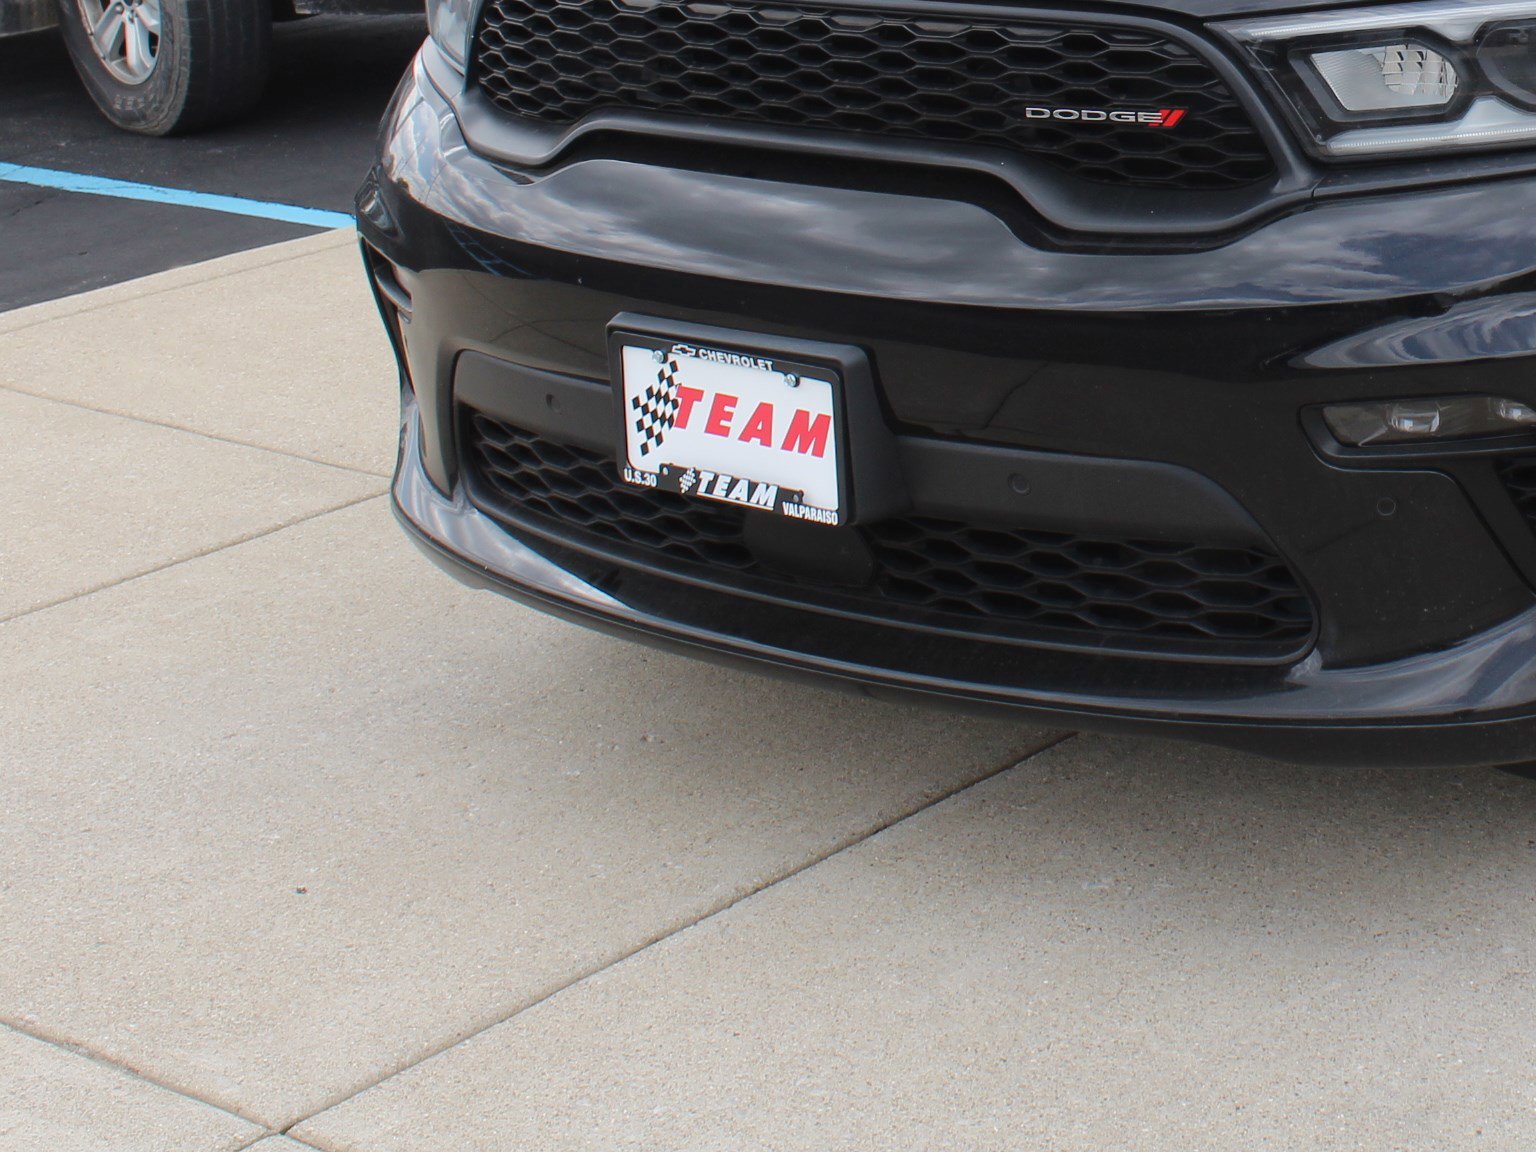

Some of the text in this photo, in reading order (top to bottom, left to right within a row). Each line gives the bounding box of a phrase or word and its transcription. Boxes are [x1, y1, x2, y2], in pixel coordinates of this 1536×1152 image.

[1025, 107, 1164, 124] DODGE
[698, 348, 774, 372] CHEVROLET
[673, 385, 832, 459] TEAM
[696, 469, 780, 509] TEAM
[782, 500, 839, 526] VALPARAISO
